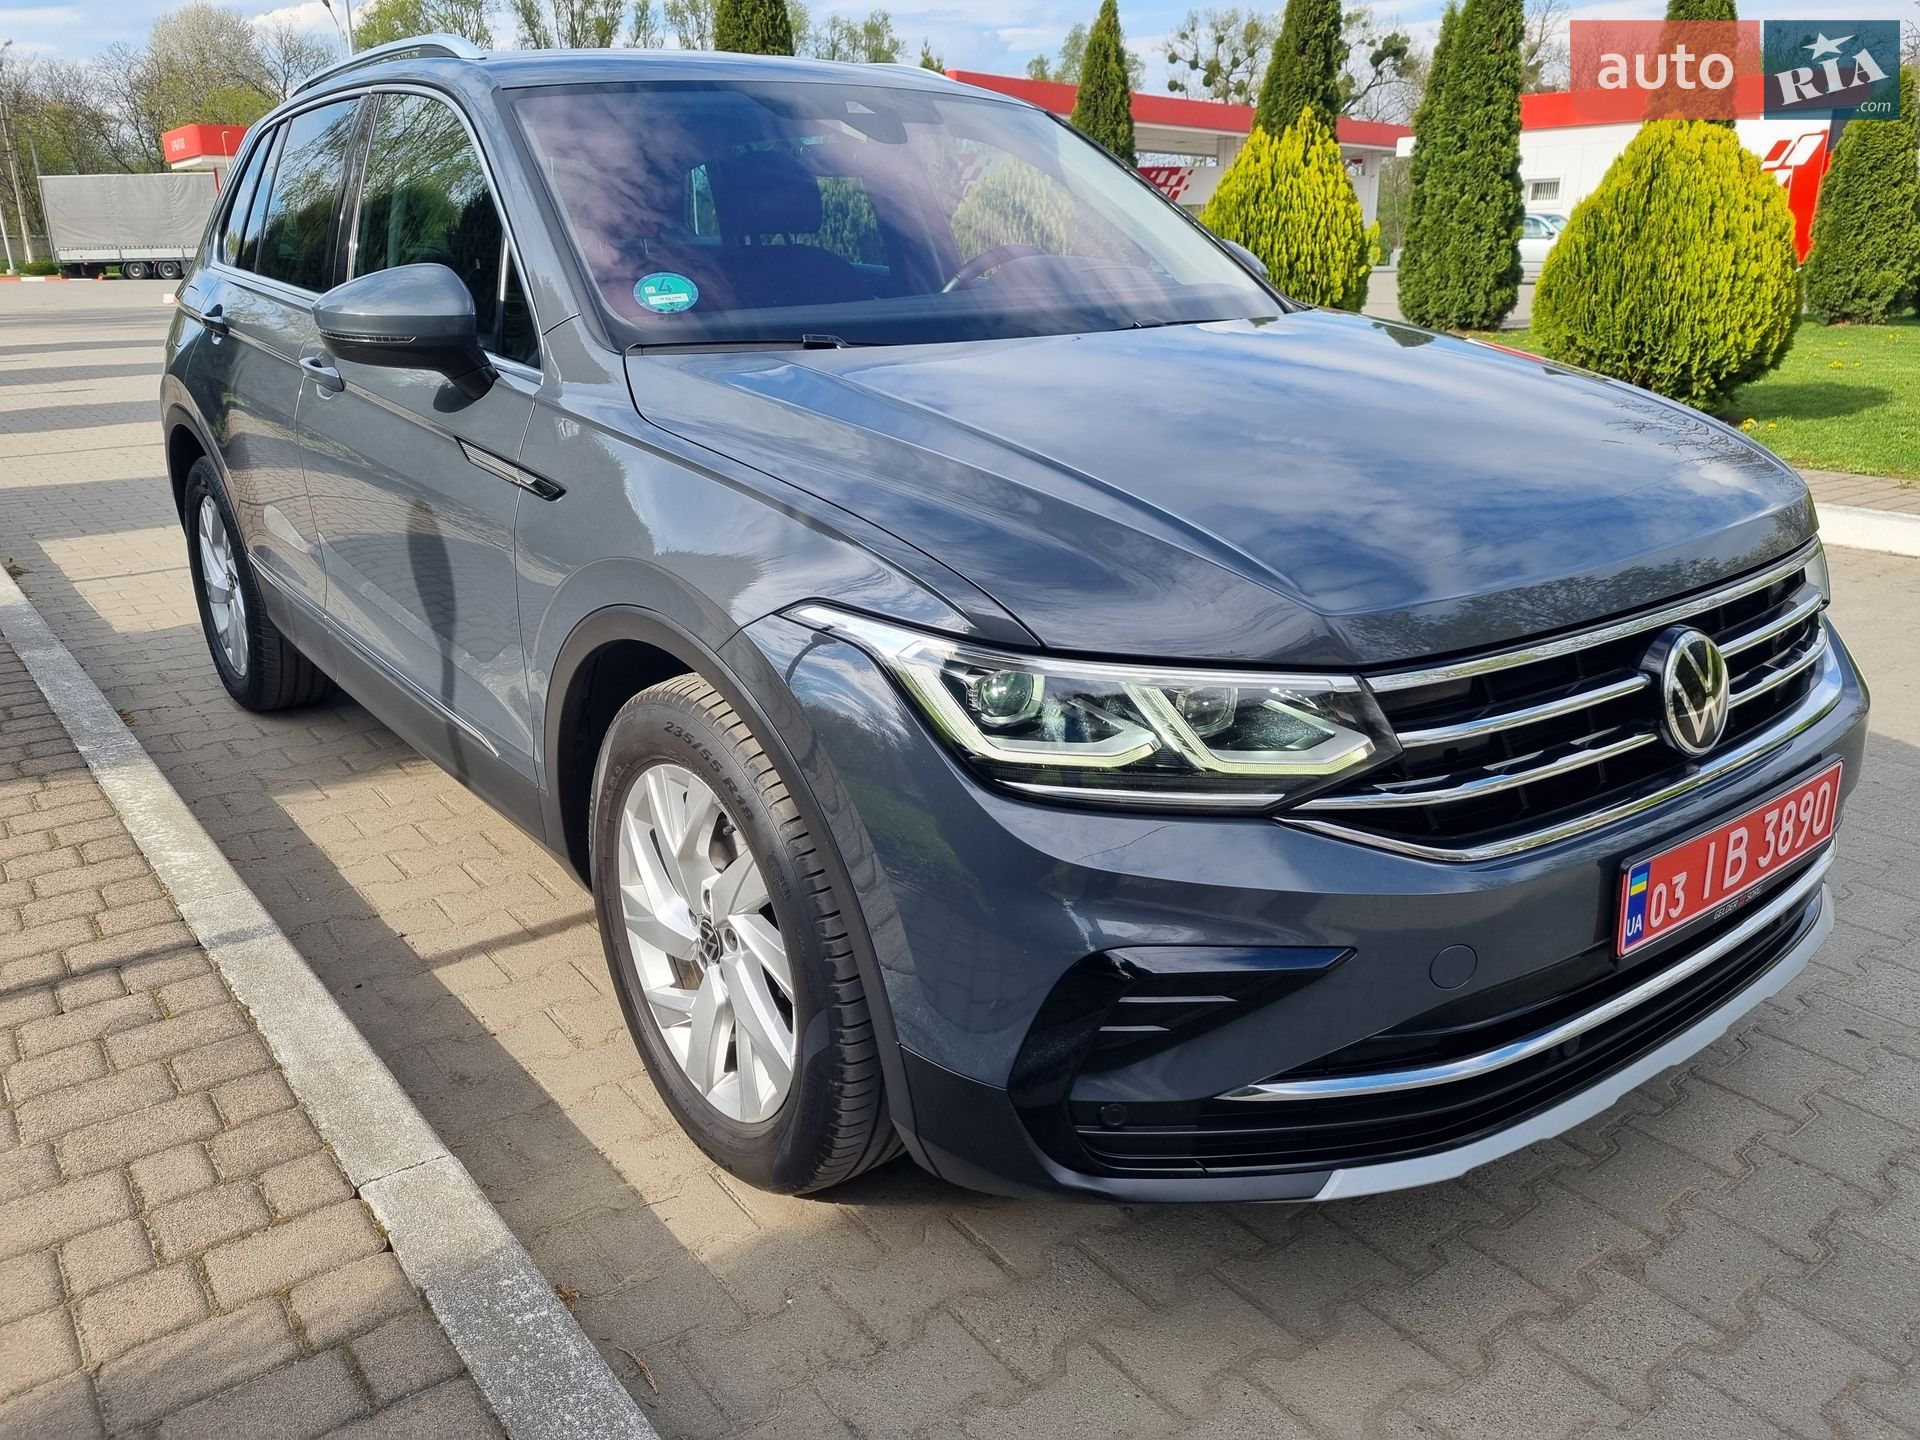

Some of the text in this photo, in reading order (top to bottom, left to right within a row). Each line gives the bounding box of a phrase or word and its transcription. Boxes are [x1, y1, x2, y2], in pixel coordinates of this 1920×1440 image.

[664, 721, 723, 773] 235/55
[1650, 781, 1831, 928] 03 IB 3890
[1626, 913, 1642, 937] UA
